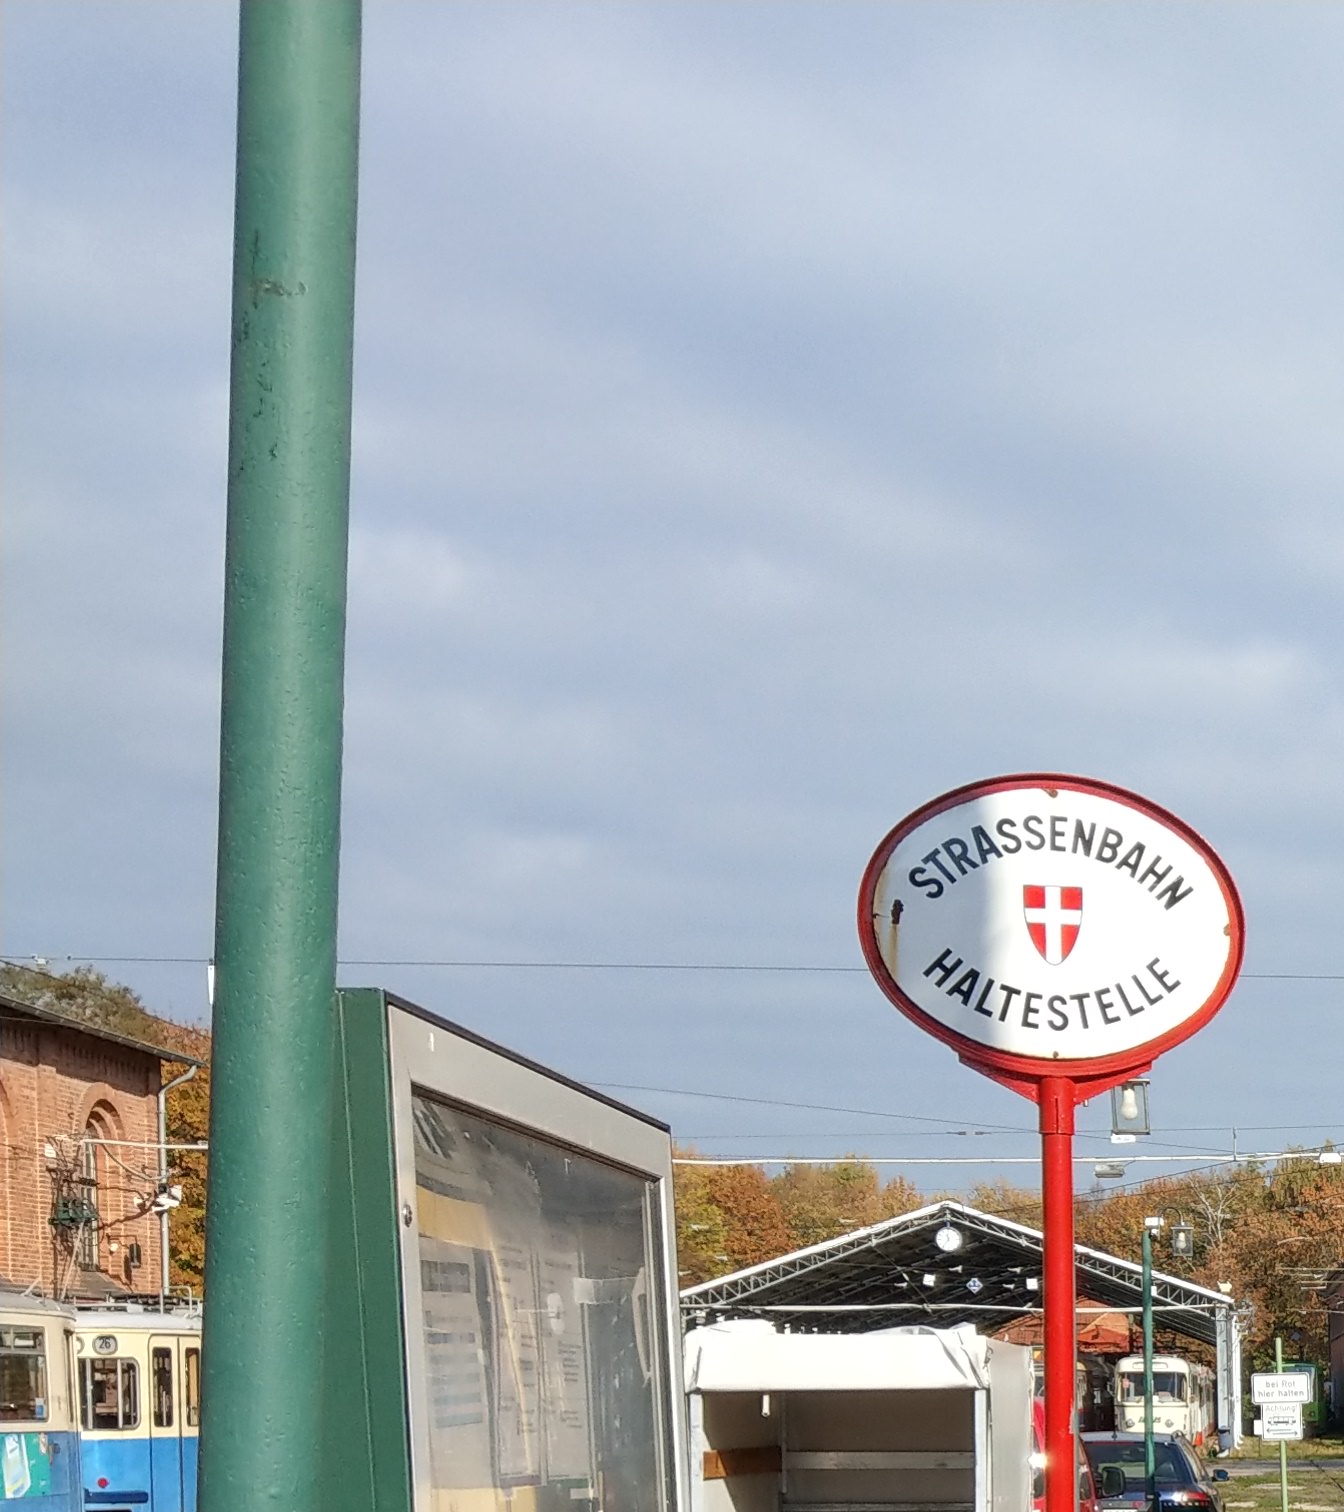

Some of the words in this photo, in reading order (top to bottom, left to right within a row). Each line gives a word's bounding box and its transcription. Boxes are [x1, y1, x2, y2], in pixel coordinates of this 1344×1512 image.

[908, 814, 1194, 911] STRASSENBAHN
[922, 948, 1182, 1032] HALTESTELLE
[98, 1337, 111, 1349] 26
[1265, 1380, 1279, 1388] bei
[1282, 1380, 1296, 1388] Rot
[1257, 1390, 1275, 1398] hier
[1278, 1389, 1305, 1397] halten
